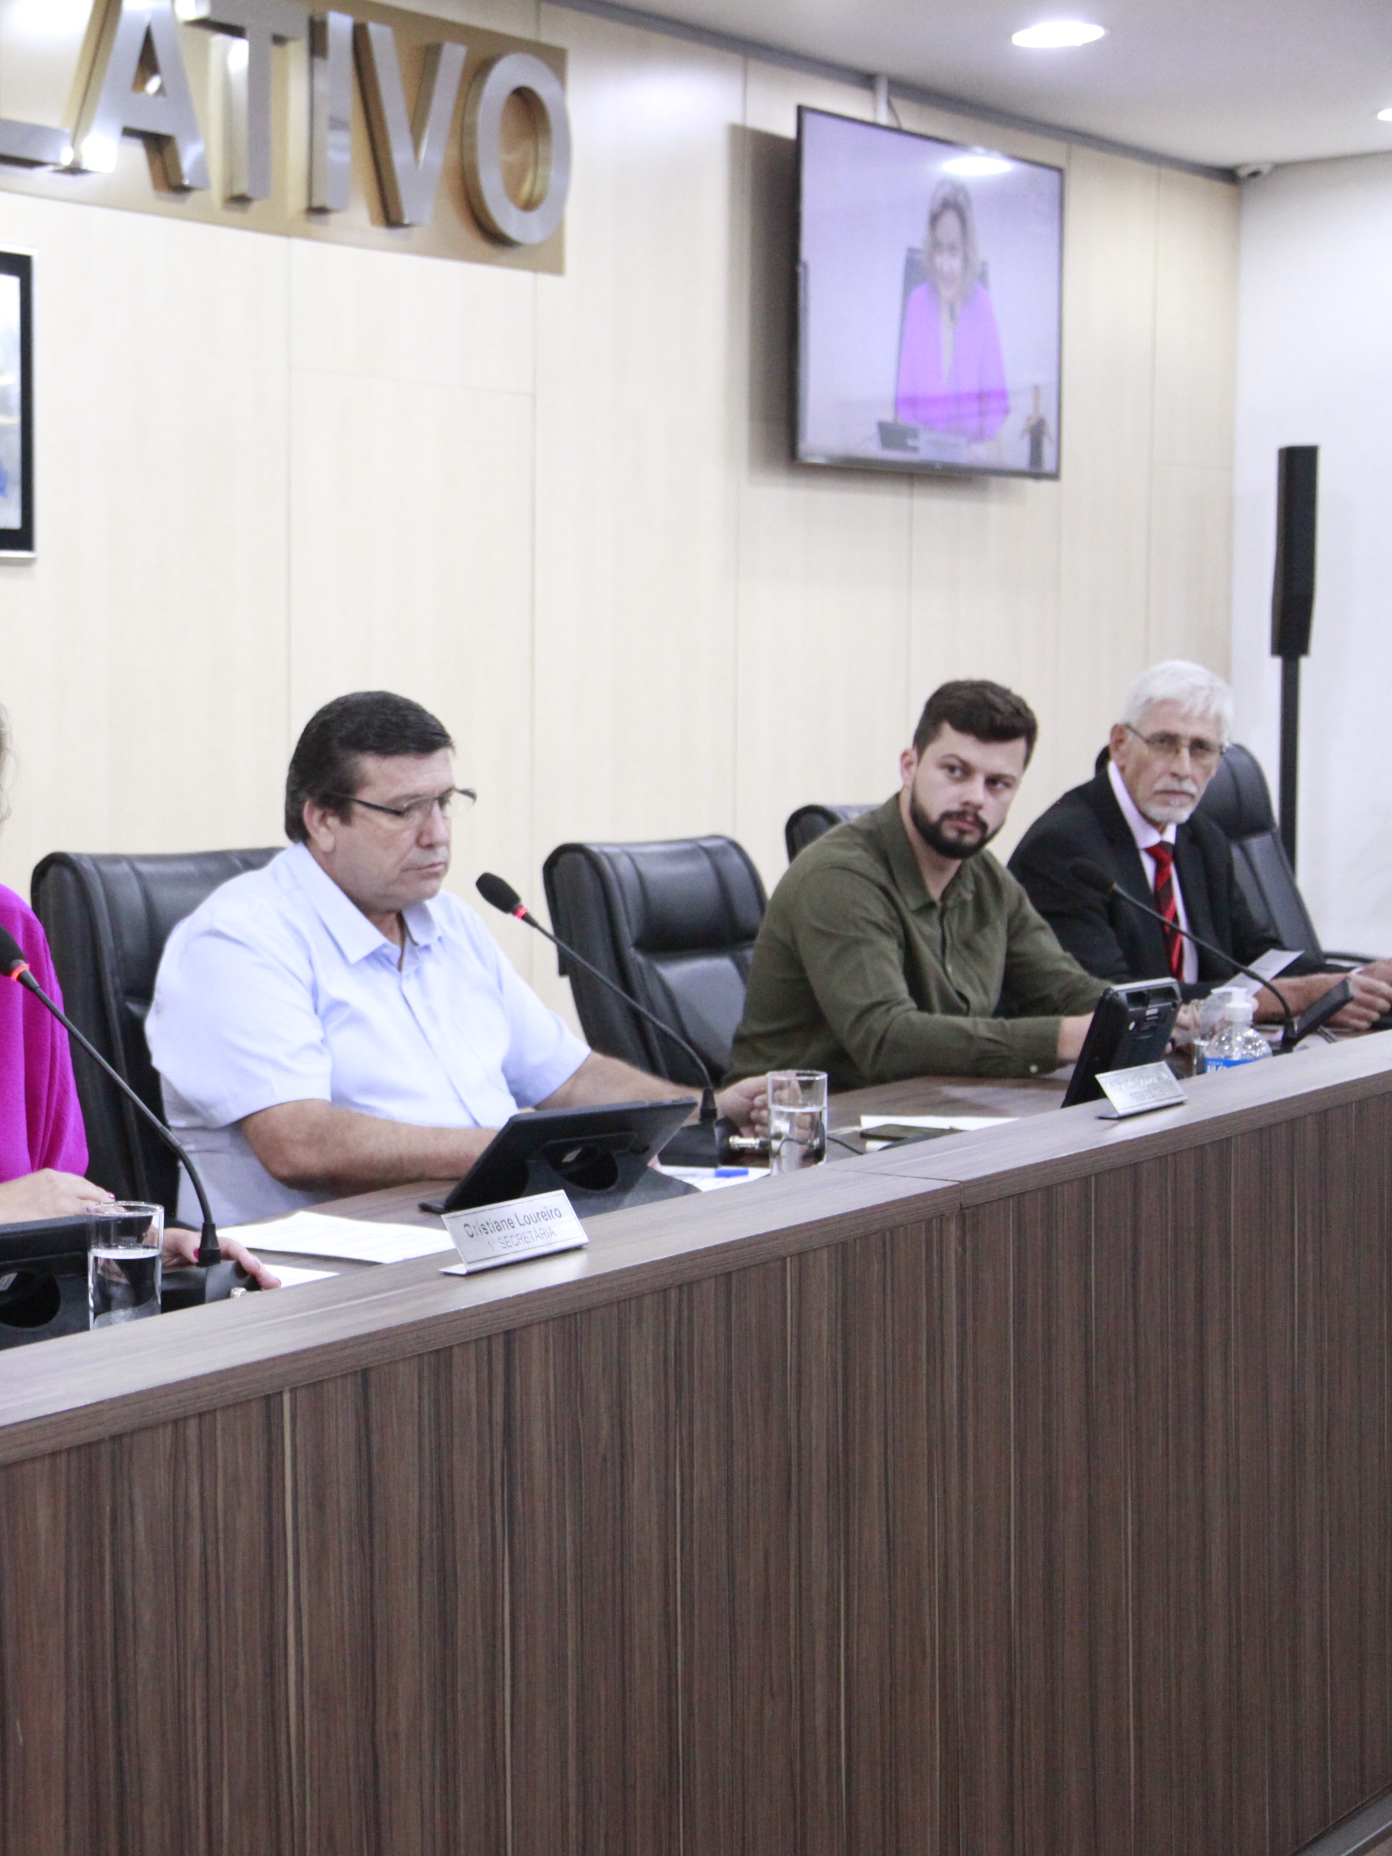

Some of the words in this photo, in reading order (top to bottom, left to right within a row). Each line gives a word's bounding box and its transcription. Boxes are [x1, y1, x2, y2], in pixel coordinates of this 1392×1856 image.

[463, 1217, 515, 1239] Cristiane
[514, 1206, 562, 1227] Loureiro
[498, 1226, 557, 1250] SECRETÁRIA
